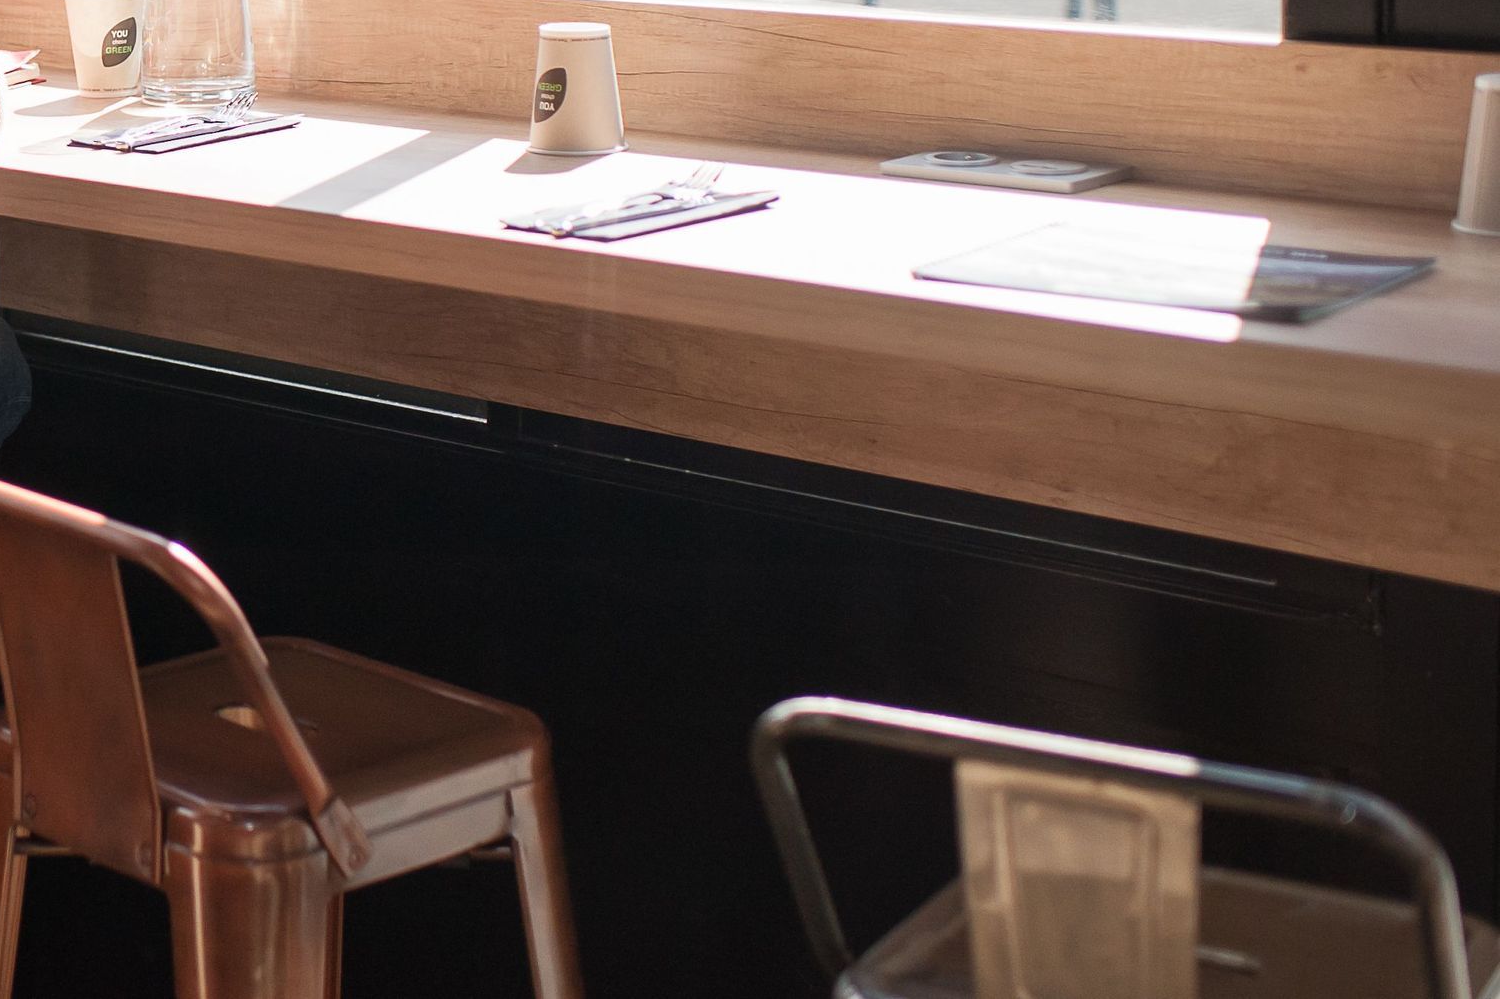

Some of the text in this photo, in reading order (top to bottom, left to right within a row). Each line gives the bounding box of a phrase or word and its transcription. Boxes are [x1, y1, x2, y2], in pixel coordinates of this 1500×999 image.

[111, 29, 128, 38] YOU
[105, 46, 132, 54] GREEN
[540, 102, 555, 111] YOU
